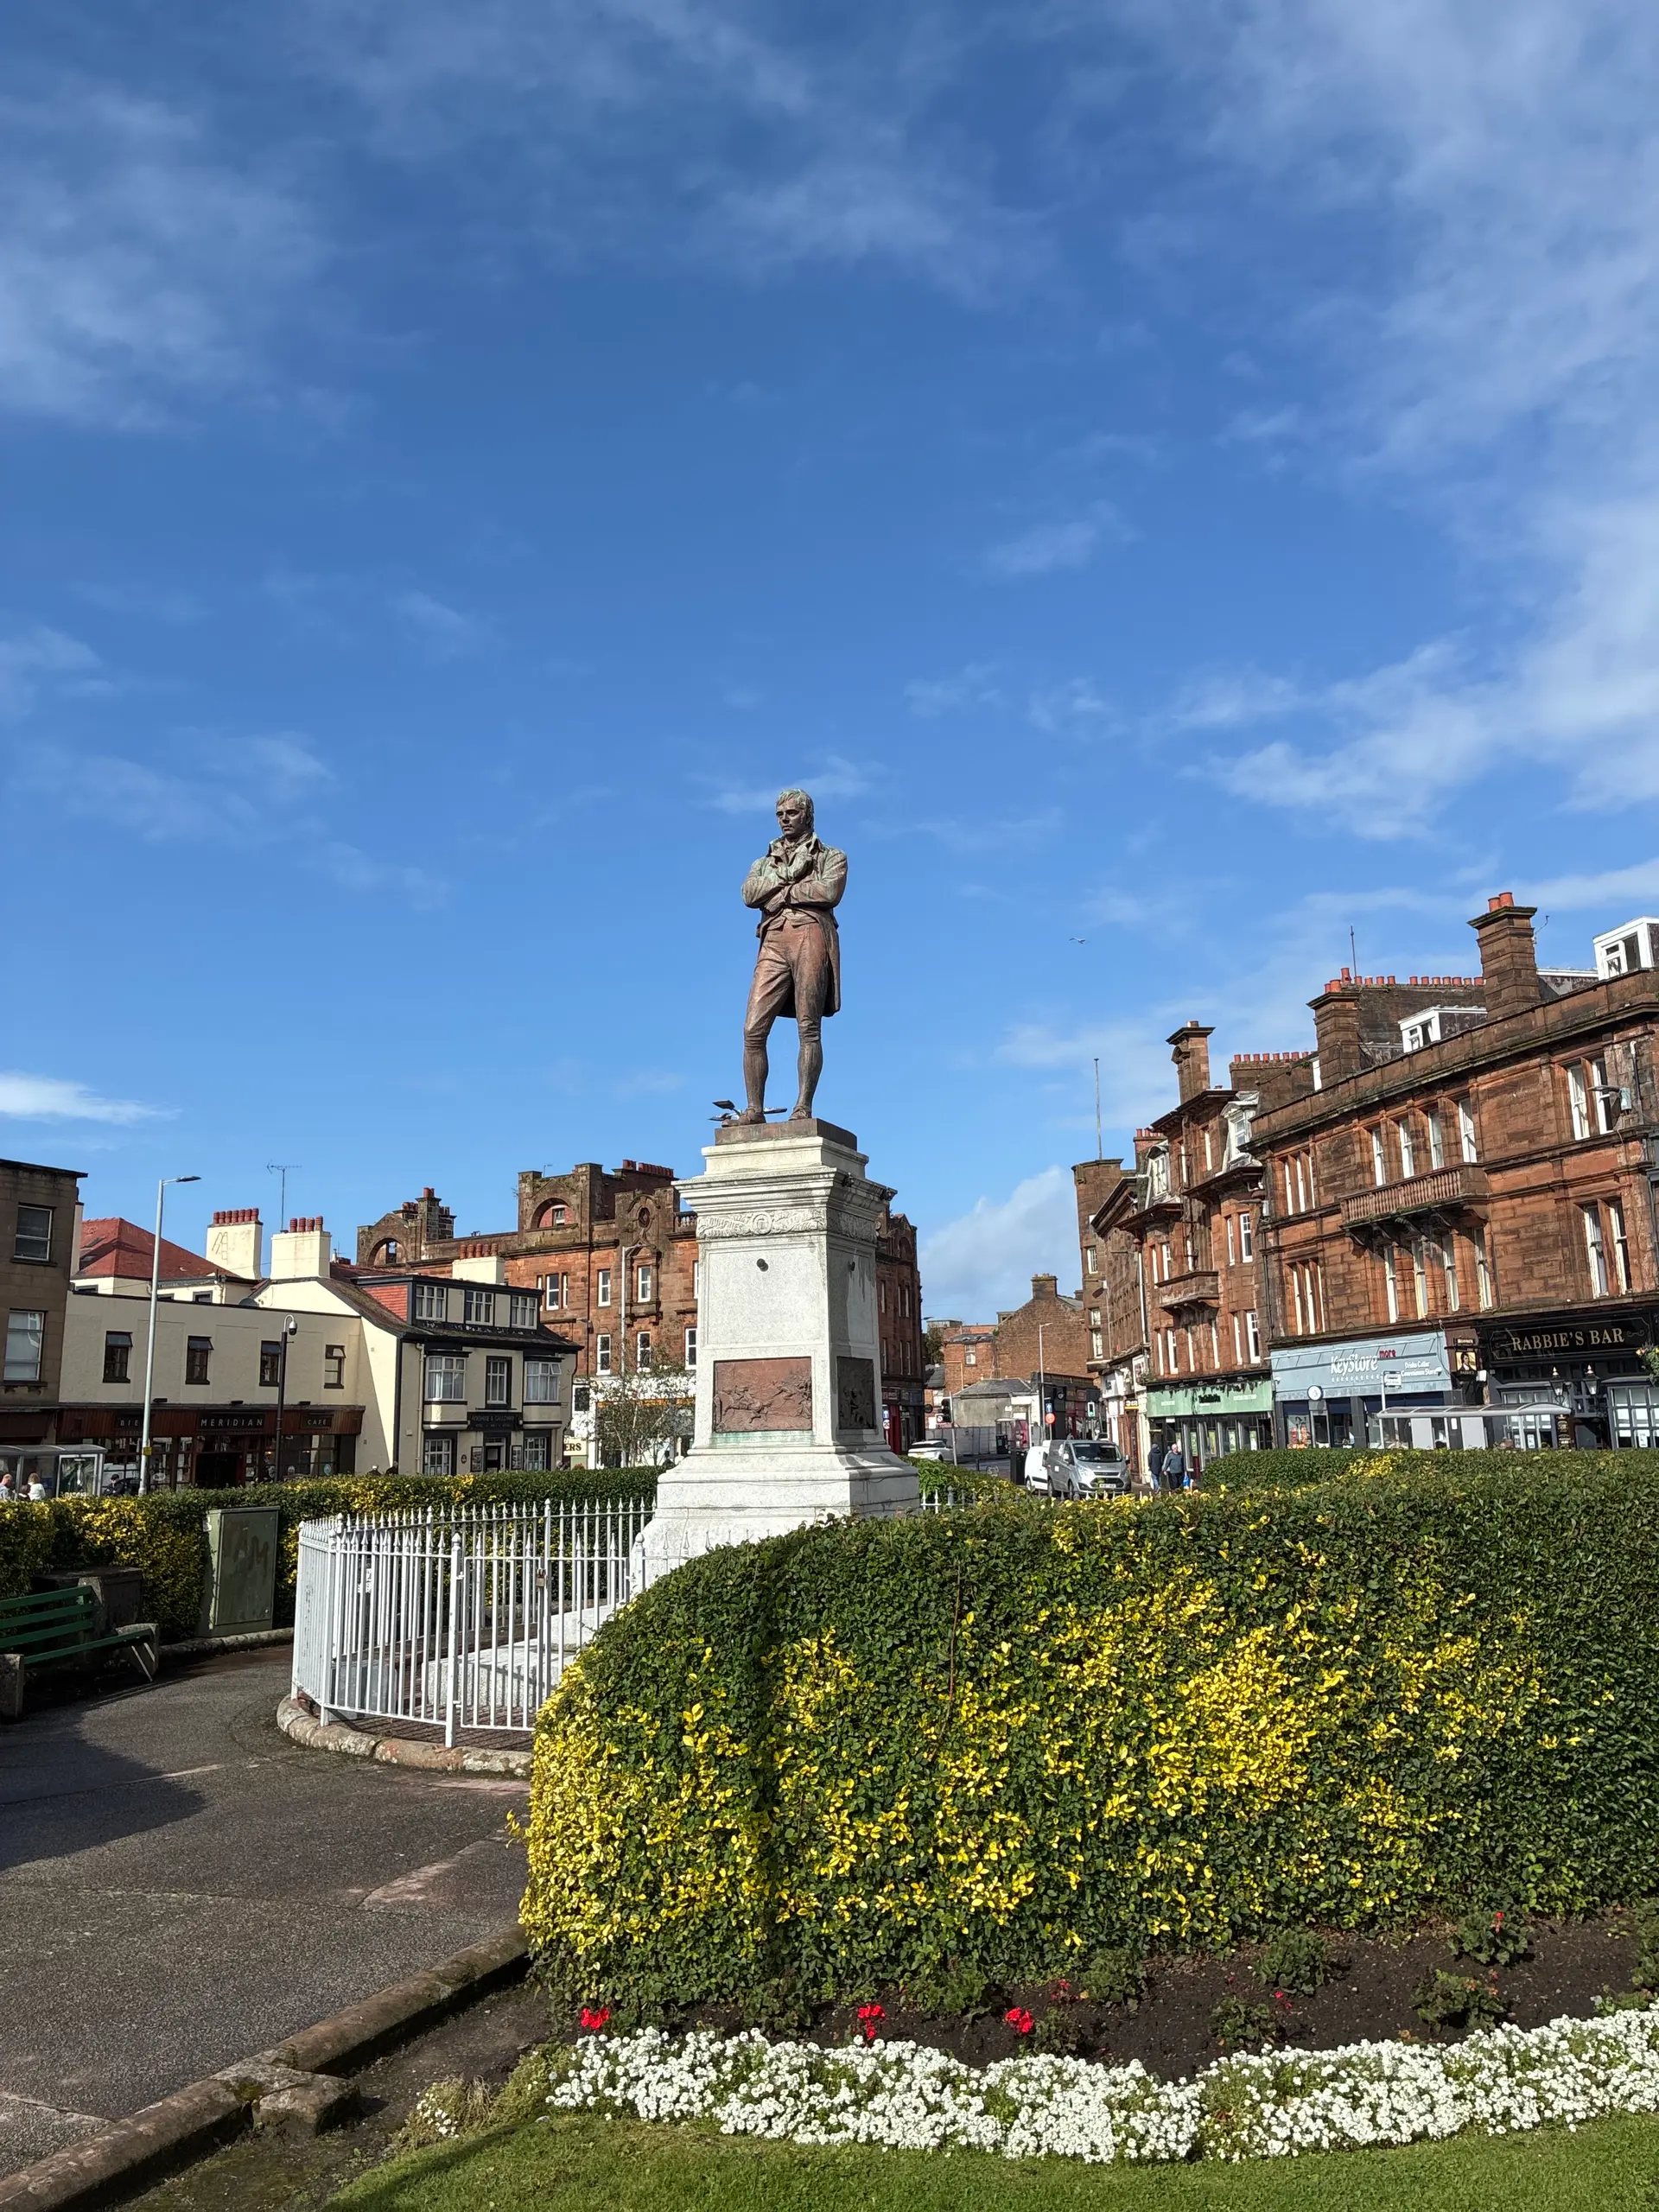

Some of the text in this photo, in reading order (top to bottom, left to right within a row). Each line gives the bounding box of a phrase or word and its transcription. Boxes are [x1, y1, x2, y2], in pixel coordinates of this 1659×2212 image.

[1512, 1328, 1625, 1351] RABBIE'S BAR
[1330, 1349, 1396, 1376] KeyStore more
[200, 1418, 263, 1427] MERIDIAN
